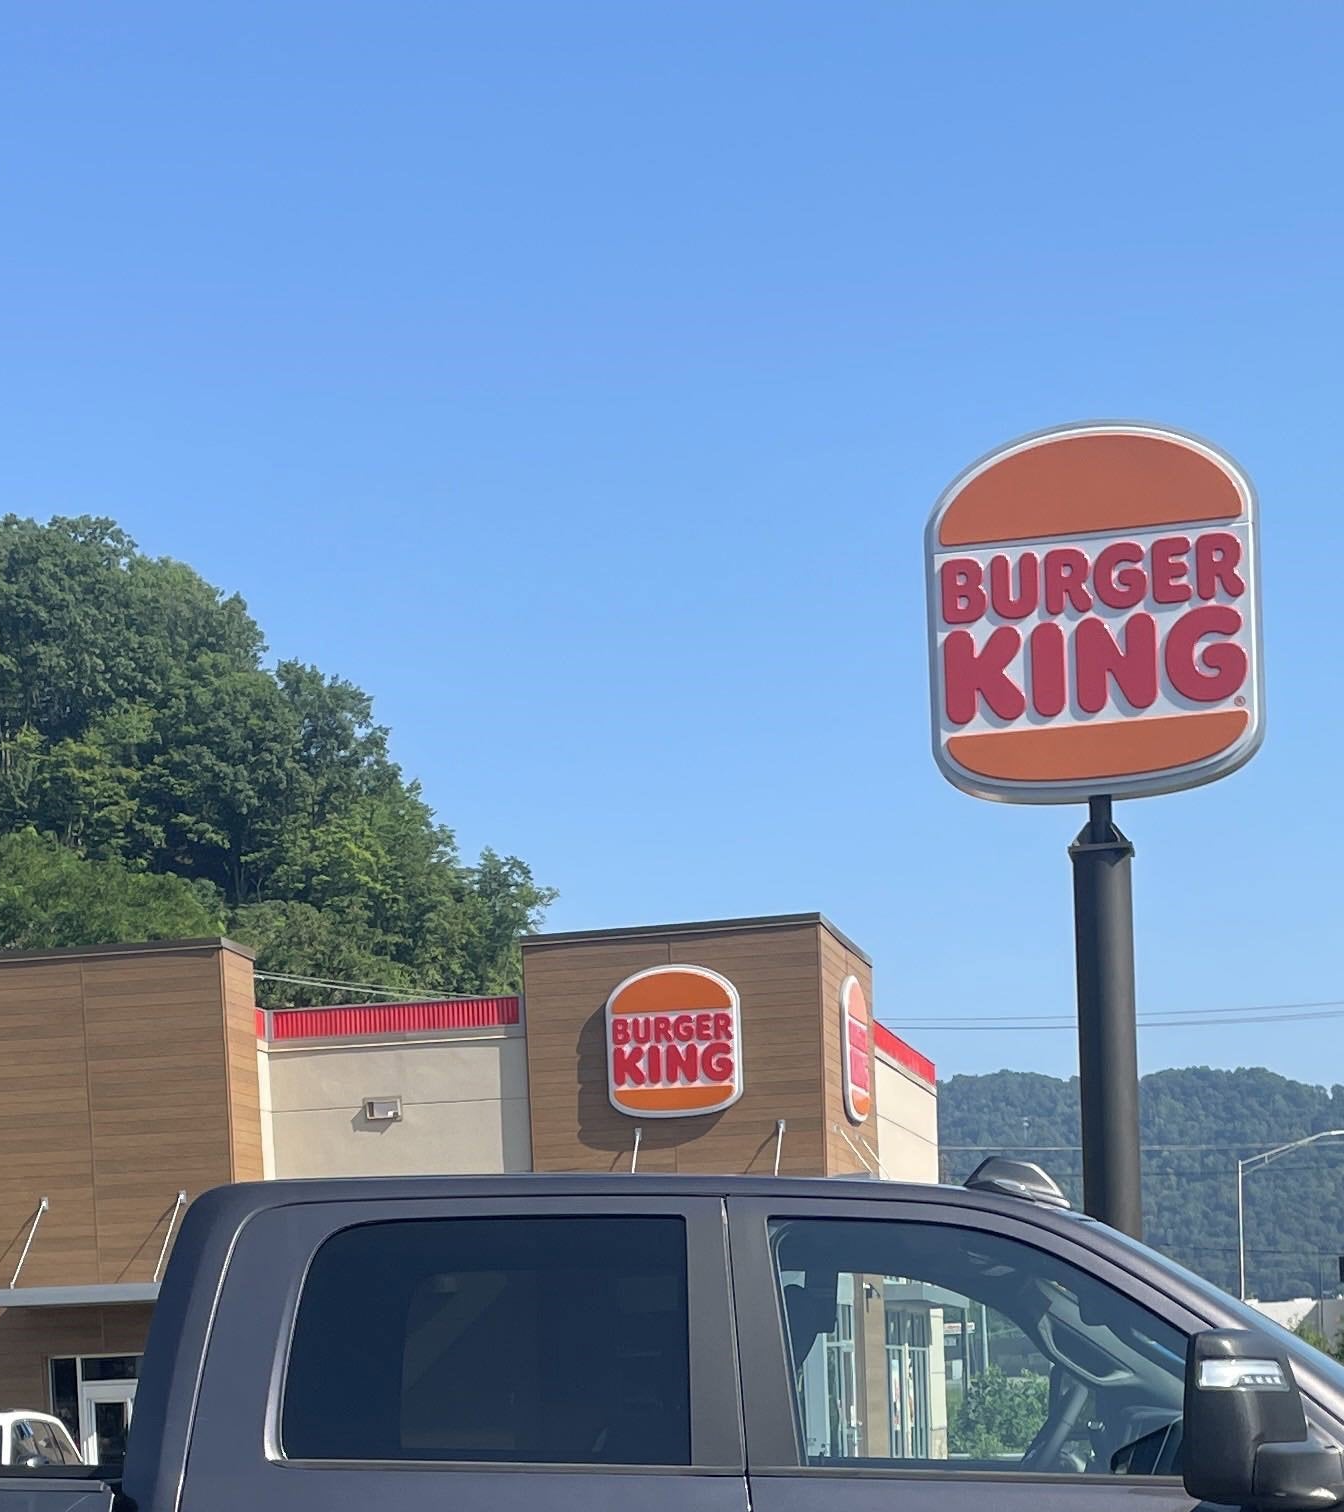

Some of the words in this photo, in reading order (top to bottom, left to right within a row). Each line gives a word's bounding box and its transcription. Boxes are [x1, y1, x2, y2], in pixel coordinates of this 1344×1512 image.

[940, 531, 1246, 625] BURGER
[943, 604, 1248, 725] KING
[612, 1012, 733, 1044] BURGER
[613, 1042, 735, 1087] KING
